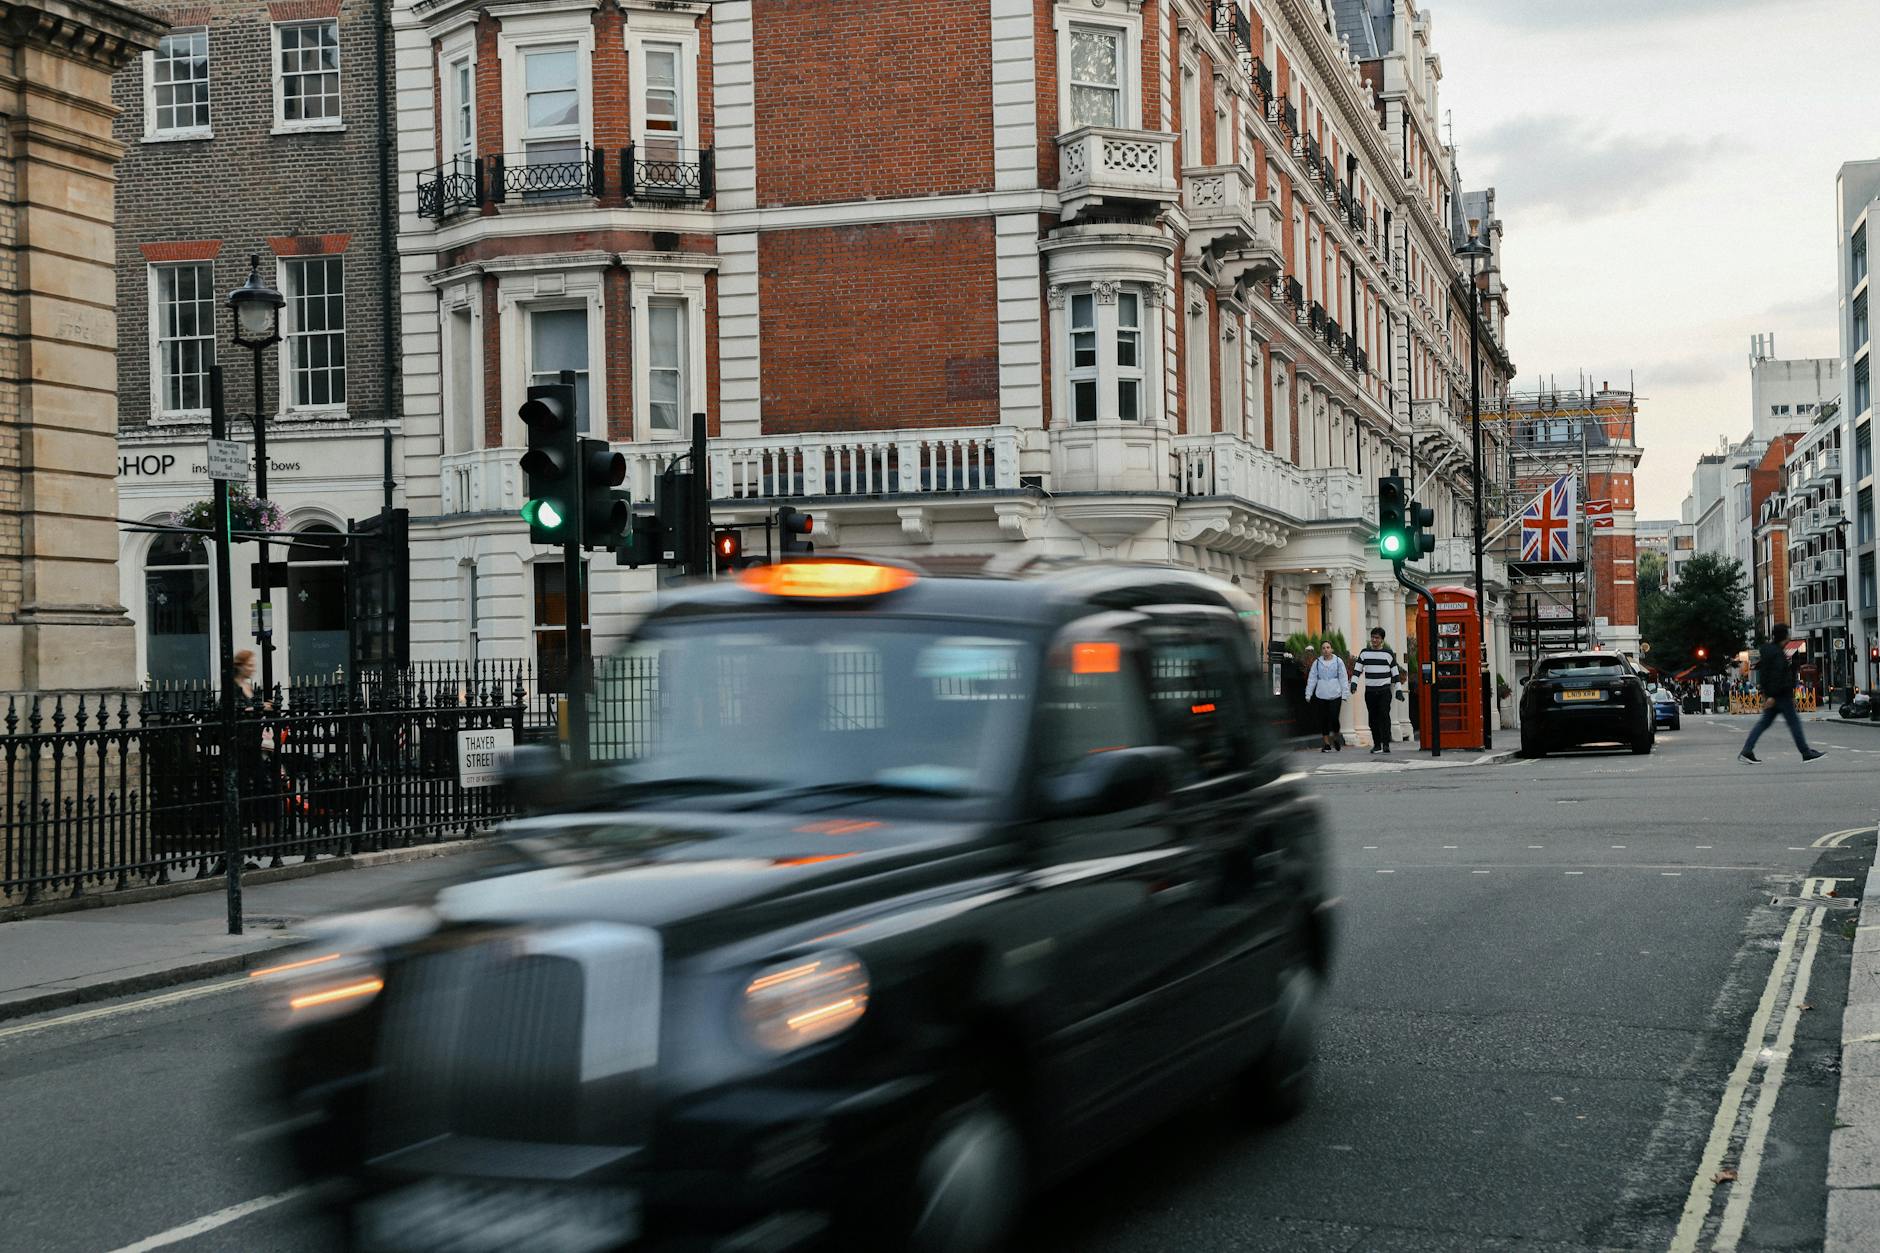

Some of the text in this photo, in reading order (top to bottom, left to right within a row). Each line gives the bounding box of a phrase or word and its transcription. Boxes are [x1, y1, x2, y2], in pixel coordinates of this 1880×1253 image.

[271, 460, 301, 472] bows
[465, 736, 495, 751] THAYER
[466, 753, 495, 768] STREET
